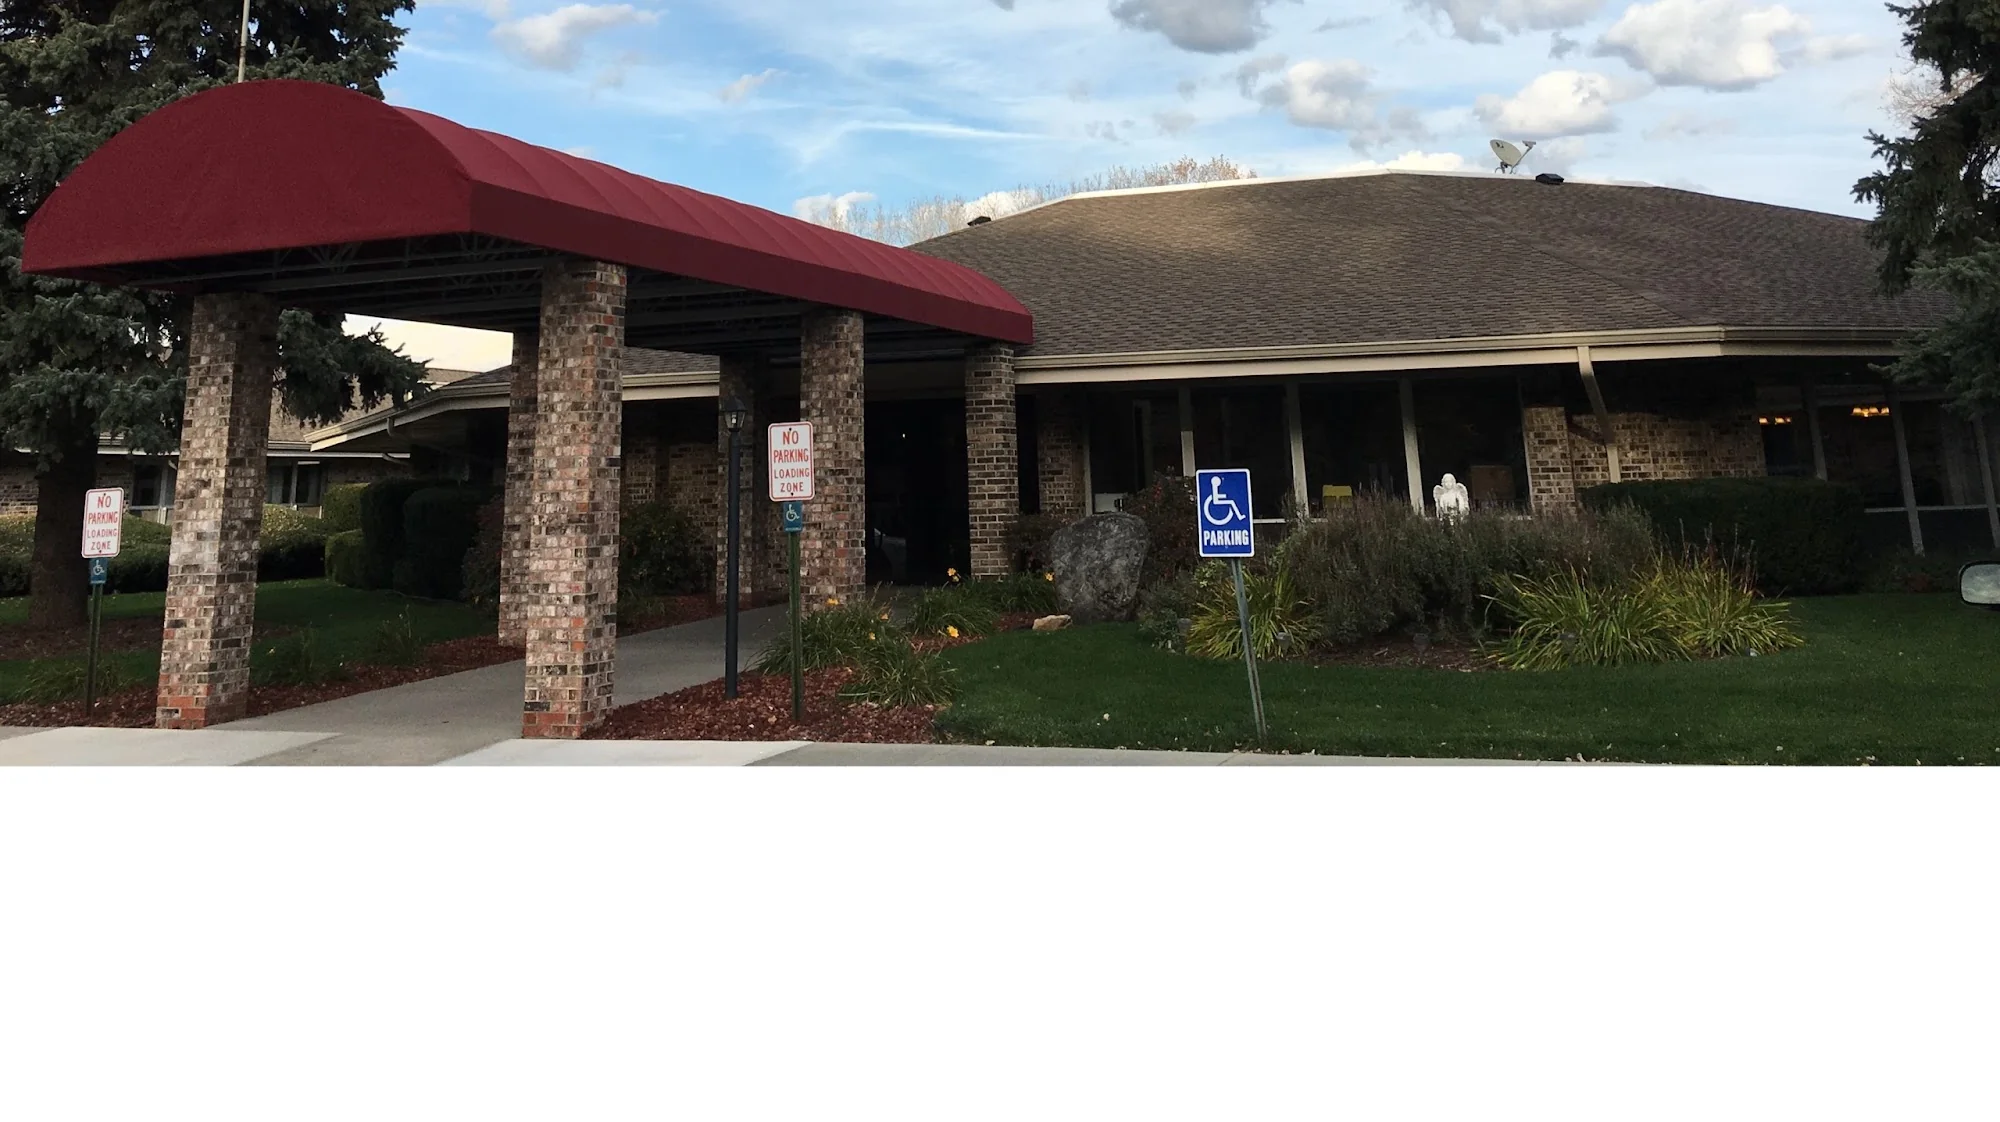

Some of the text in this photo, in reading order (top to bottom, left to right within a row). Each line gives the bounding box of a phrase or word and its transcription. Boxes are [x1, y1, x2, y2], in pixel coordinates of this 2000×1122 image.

[782, 430, 799, 445] NO
[773, 448, 809, 463] PARKING
[774, 467, 810, 479] LOADING
[780, 482, 804, 493] ZONE
[97, 495, 112, 509] NO
[87, 511, 118, 525] PARKING
[87, 528, 118, 539] LOADING
[1203, 529, 1250, 546] PARKING
[90, 541, 111, 551] ZONE
